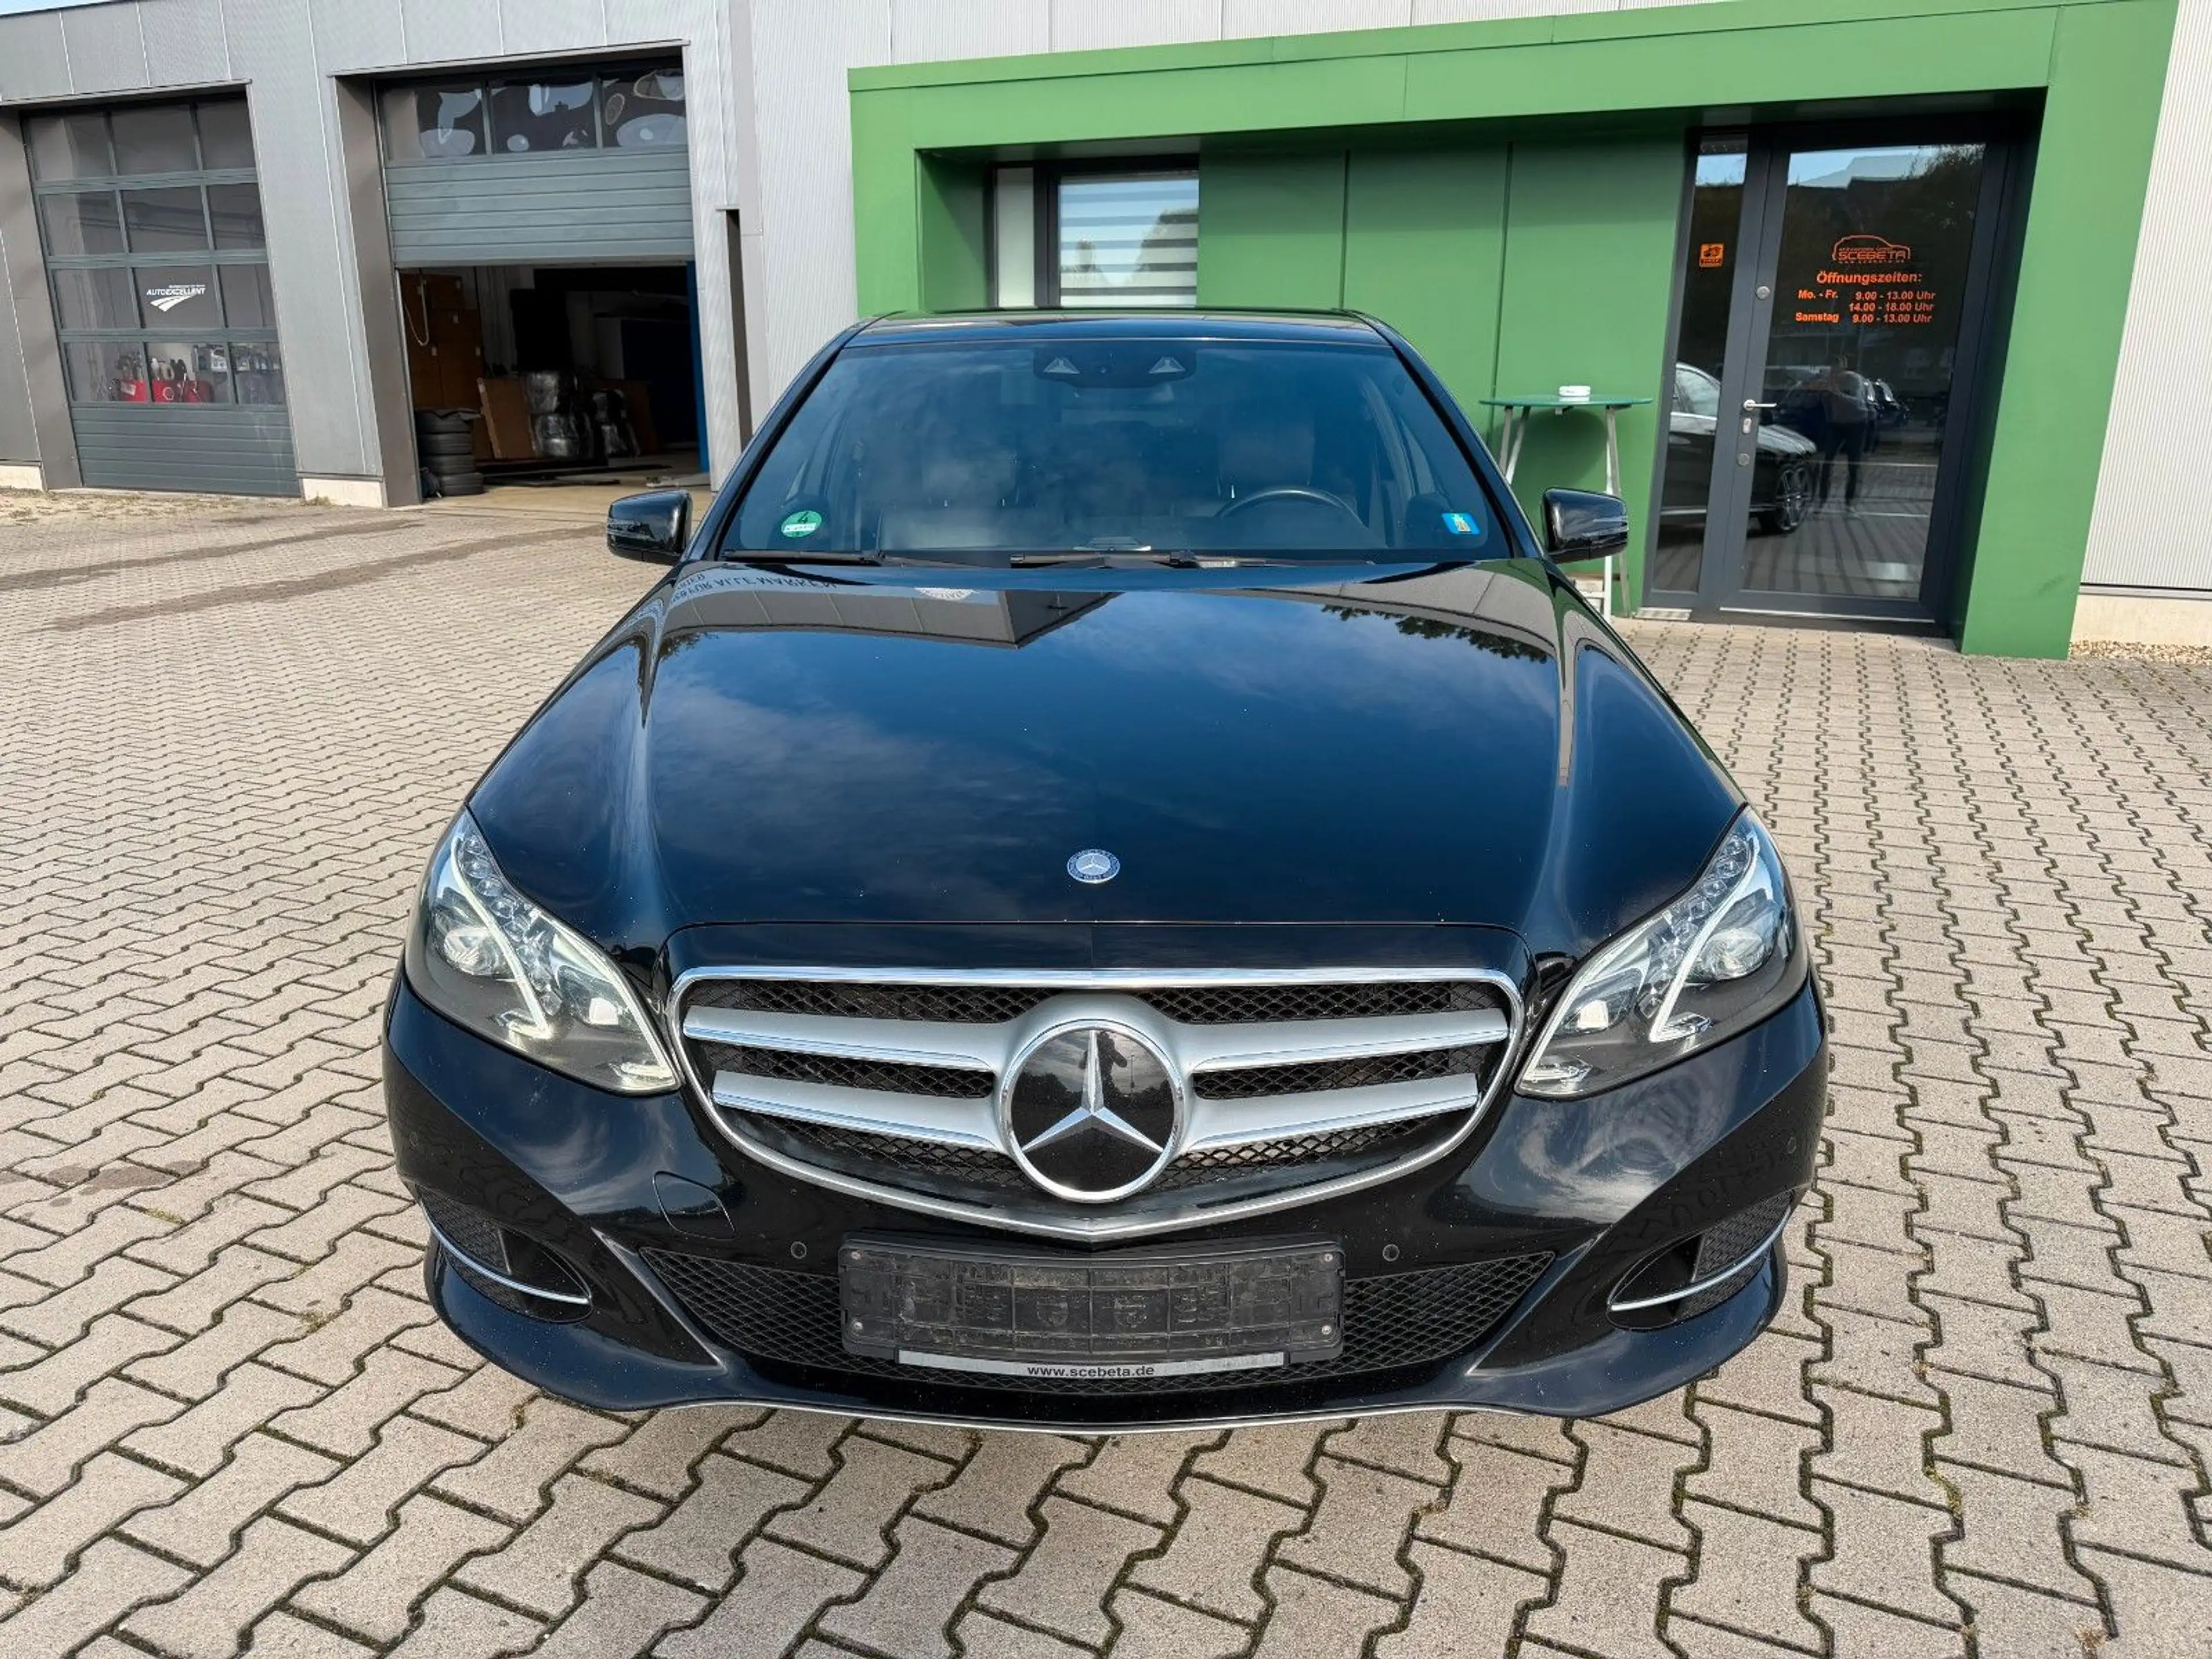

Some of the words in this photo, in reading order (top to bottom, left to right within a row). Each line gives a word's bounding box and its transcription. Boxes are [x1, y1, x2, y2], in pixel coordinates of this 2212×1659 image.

[1839, 251, 1906, 260] SCEBETA
[1816, 271, 1922, 286] Öffnungszeiten:
[1798, 290, 1816, 299] Mo.
[1825, 289, 1839, 298] Fr.
[1855, 291, 1877, 300] 9.00
[1887, 291, 1914, 300] 13.00
[1916, 291, 1936, 300] Uhr
[1849, 302, 1876, 312] 14.00
[1914, 302, 1934, 312] Uhr
[1796, 312, 1840, 323] Samstag
[1853, 313, 1874, 323] 9.00
[1883, 313, 1910, 323] 13.00
[1913, 314, 1932, 323] Uhr
[797, 512, 809, 524] 4
[1028, 1366, 1154, 1377] www.scebeta.de
